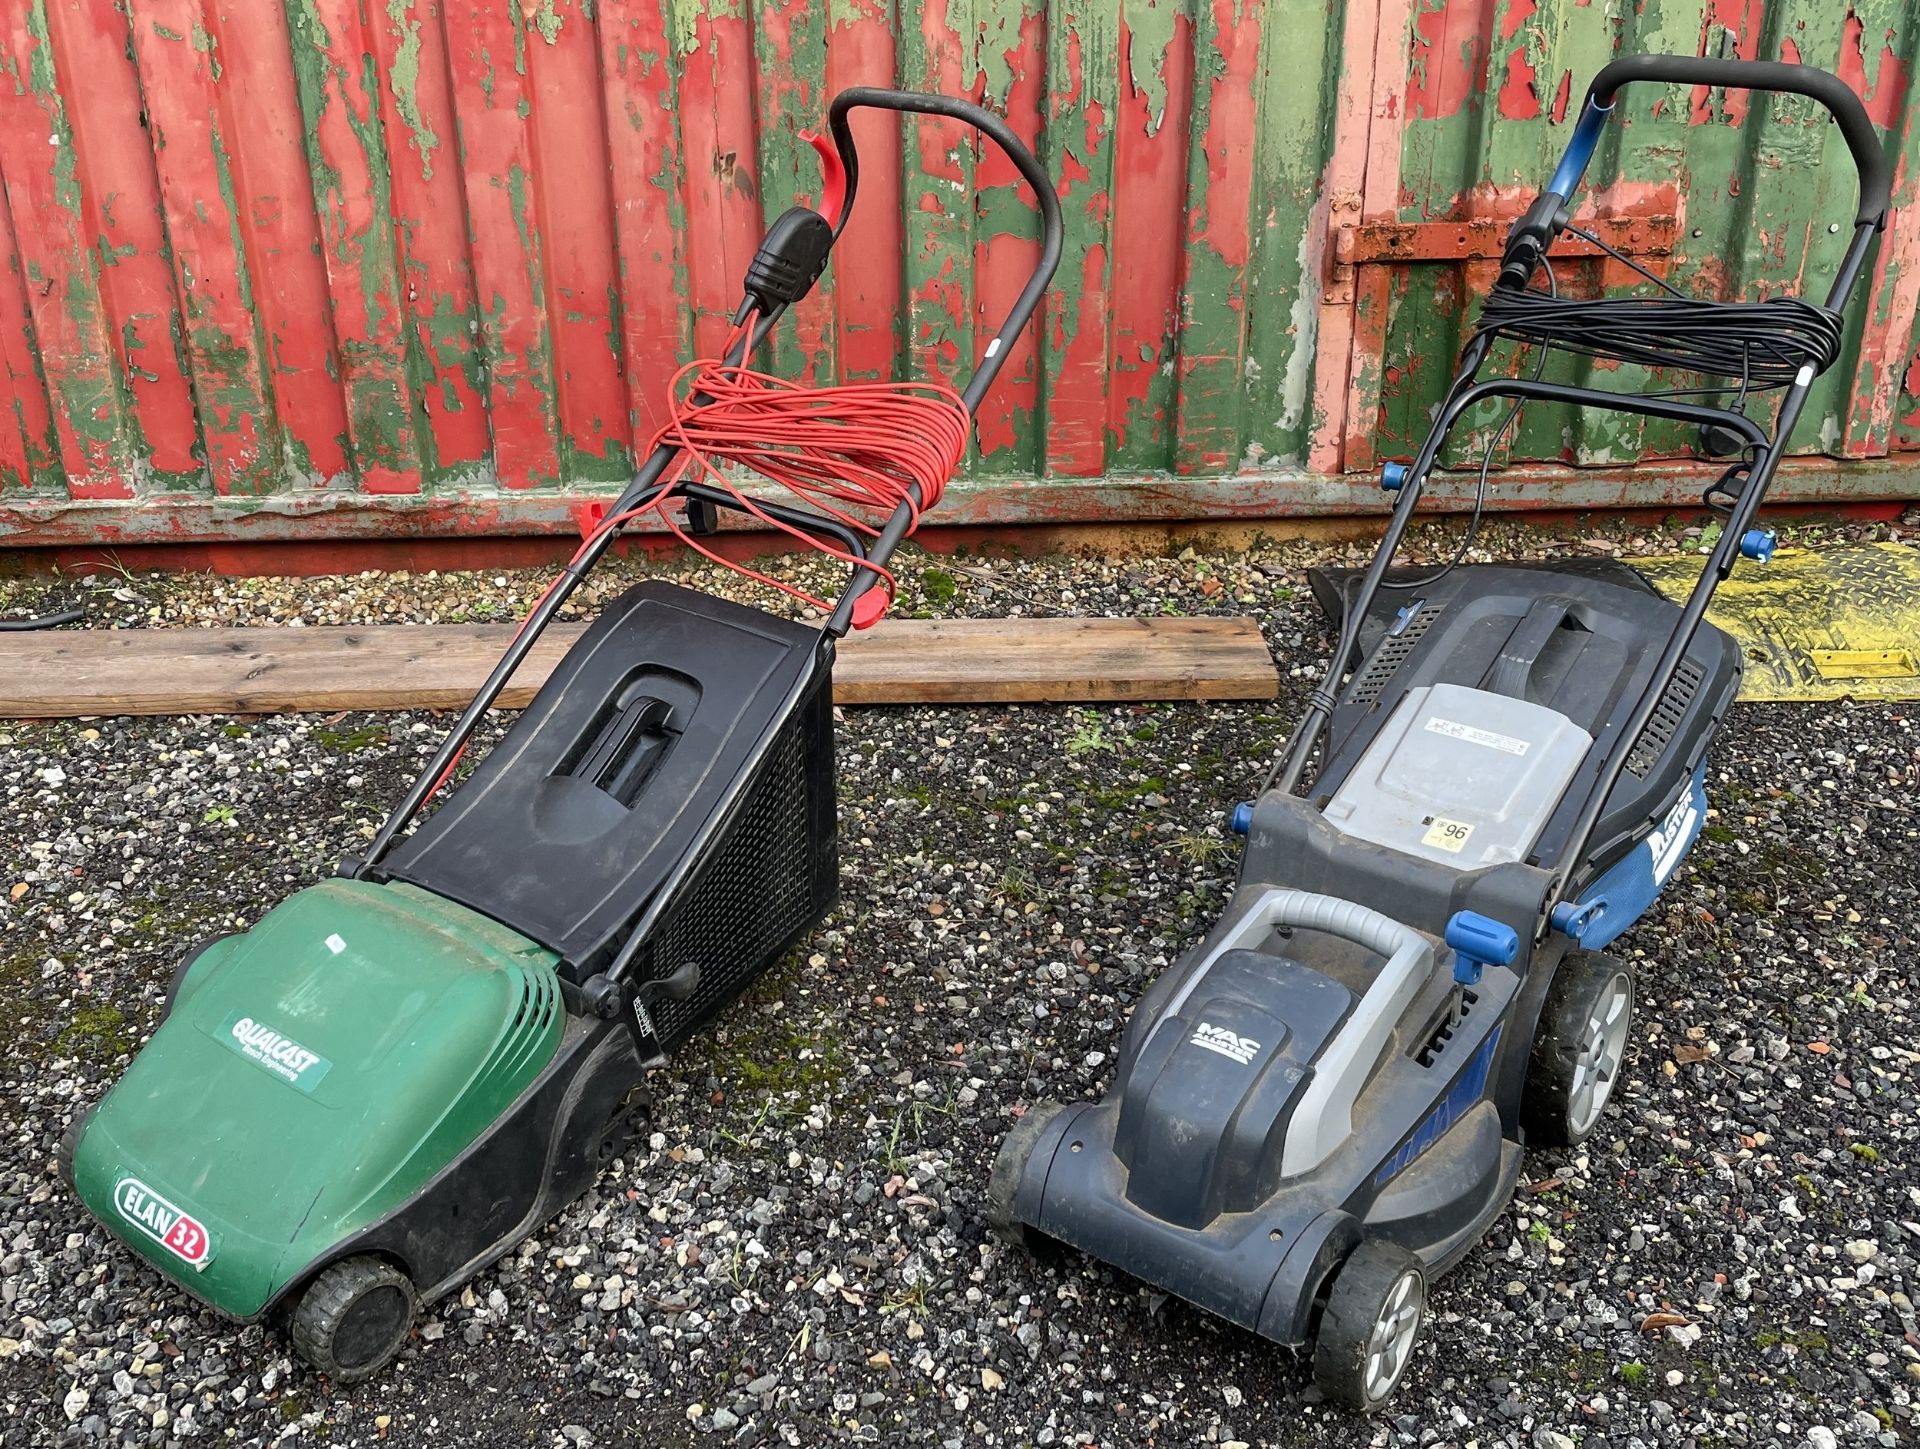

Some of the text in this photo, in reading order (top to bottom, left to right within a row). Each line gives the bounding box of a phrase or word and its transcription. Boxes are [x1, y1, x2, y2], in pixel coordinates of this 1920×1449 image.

[1444, 824, 1469, 840] 96
[232, 1017, 320, 1073] QUALCAST
[1192, 1033, 1254, 1061] ALLISTER
[1197, 1022, 1261, 1054] MAC
[242, 1043, 299, 1082] Bosch Engineering
[123, 1185, 199, 1257] ELAN 32
